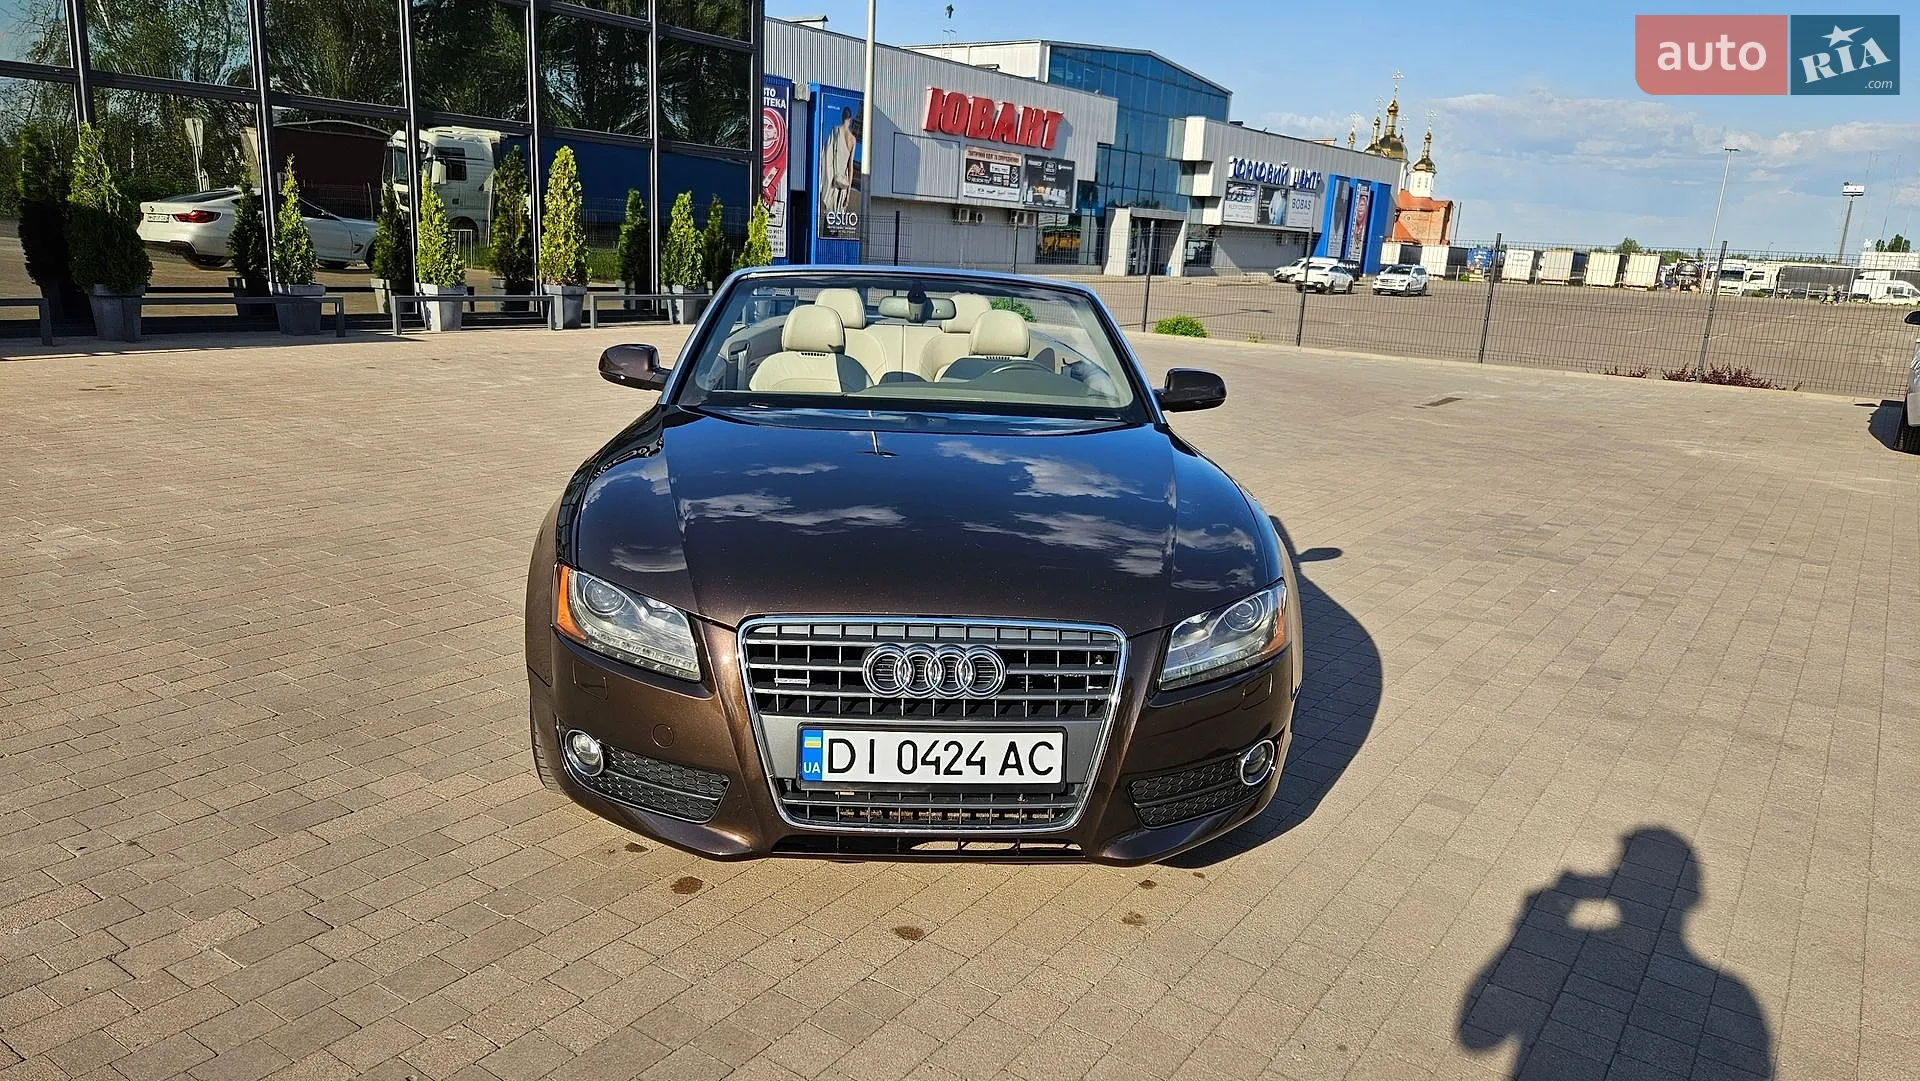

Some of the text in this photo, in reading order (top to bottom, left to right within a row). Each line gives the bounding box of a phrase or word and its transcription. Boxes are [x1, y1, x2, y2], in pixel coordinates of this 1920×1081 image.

[922, 88, 1064, 149] ЮВАНТ
[1228, 156, 1289, 185] ТОРГОВИЙ
[826, 210, 858, 226] estro
[803, 762, 821, 774] UA
[828, 738, 1055, 776] DI 0424 AC
